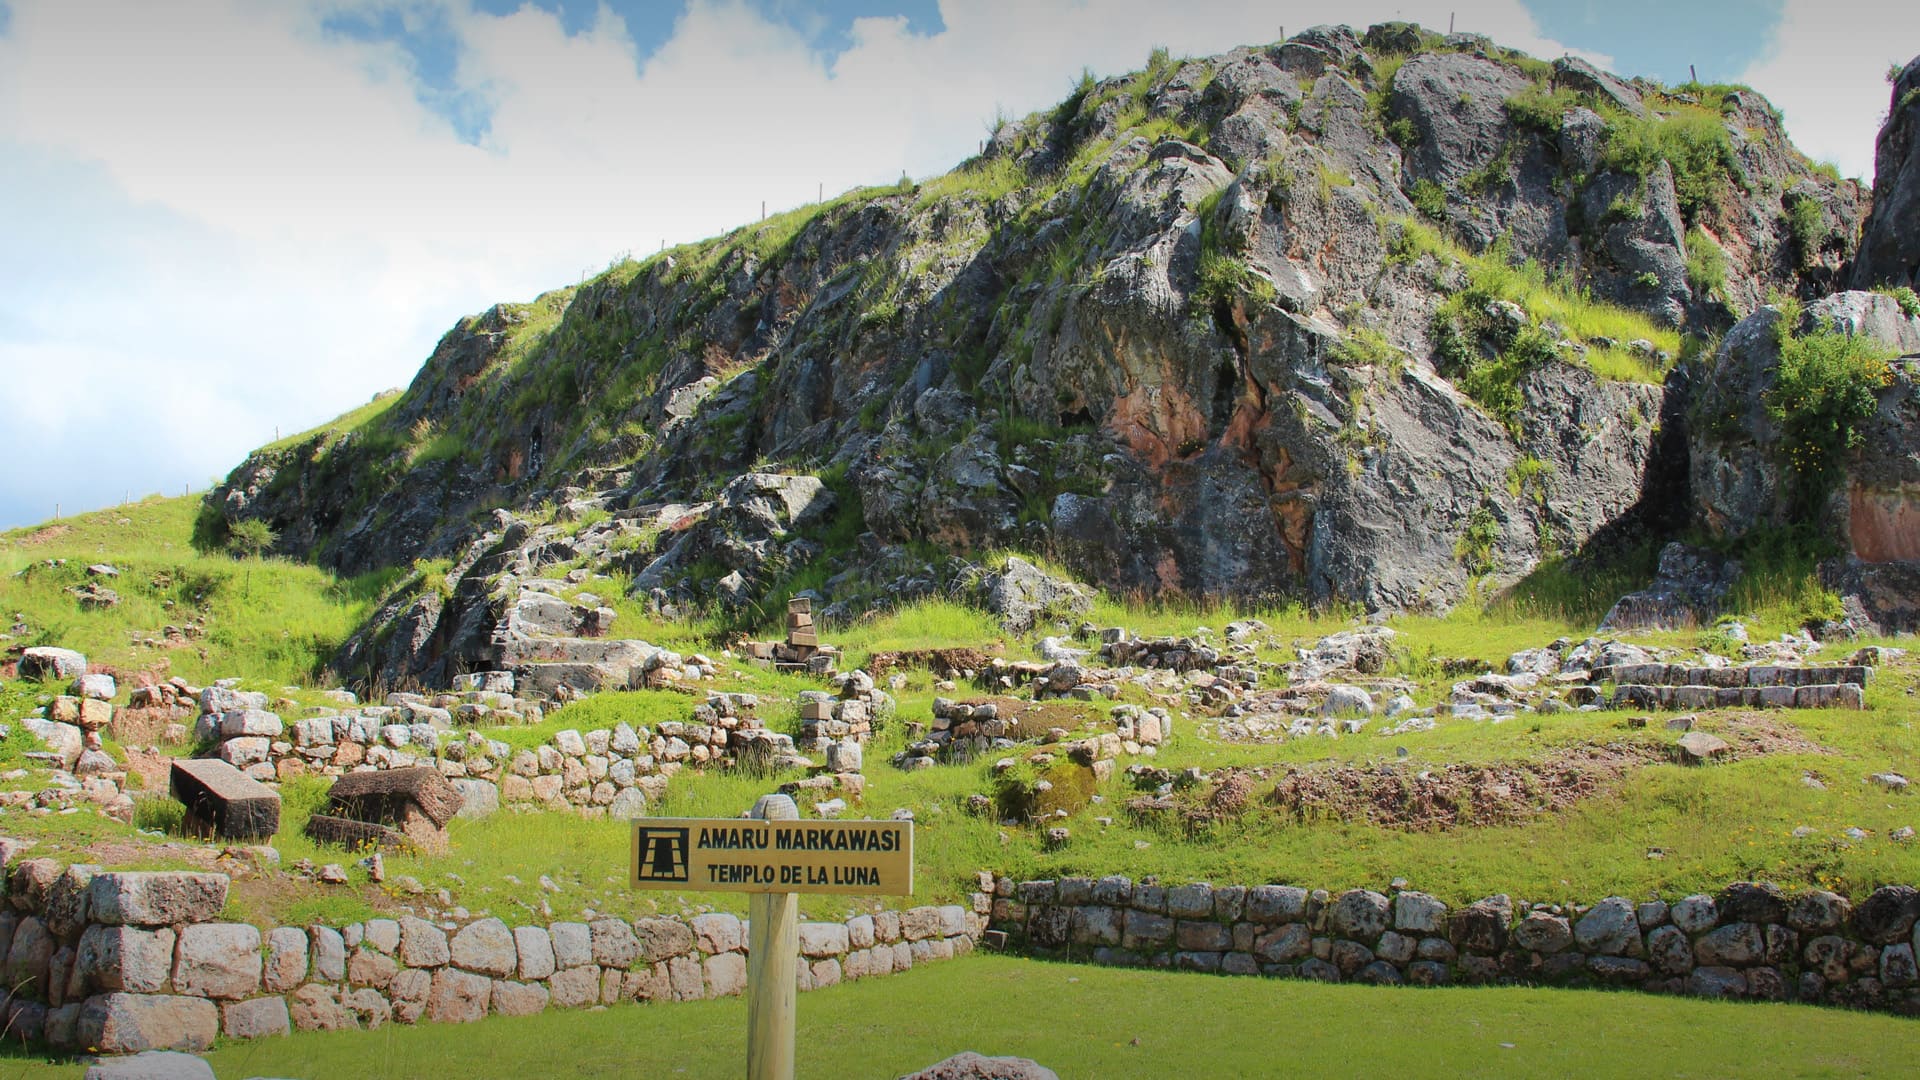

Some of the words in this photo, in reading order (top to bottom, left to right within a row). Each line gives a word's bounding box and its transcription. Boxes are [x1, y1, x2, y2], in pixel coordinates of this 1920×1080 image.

[697, 828, 768, 849] AMARU
[776, 829, 900, 851] MARKAWASI
[708, 864, 775, 883] TEMPLO
[780, 865, 802, 884] DE
[808, 866, 828, 885] LA
[834, 866, 880, 886] LUNA
